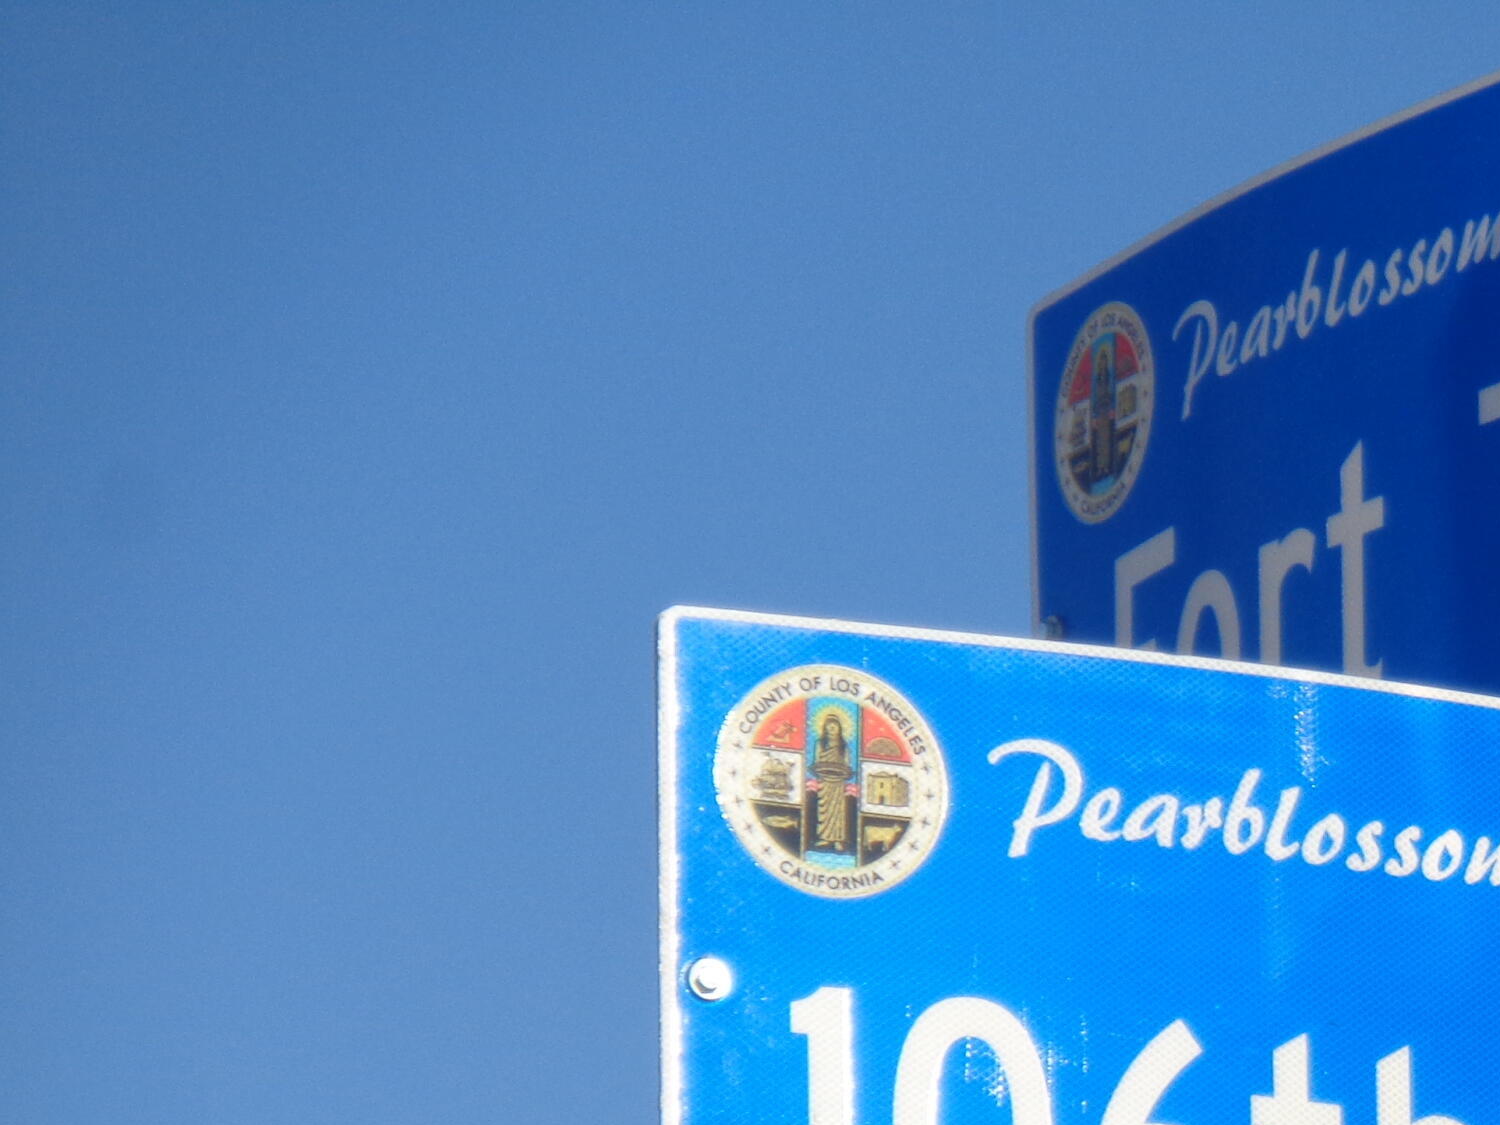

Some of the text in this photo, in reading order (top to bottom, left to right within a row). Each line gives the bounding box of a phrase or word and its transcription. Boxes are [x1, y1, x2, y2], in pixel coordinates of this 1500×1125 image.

[738, 675, 927, 757] COUNTY OF LOS ANGELES
[779, 859, 885, 890] CALIFORNIA
